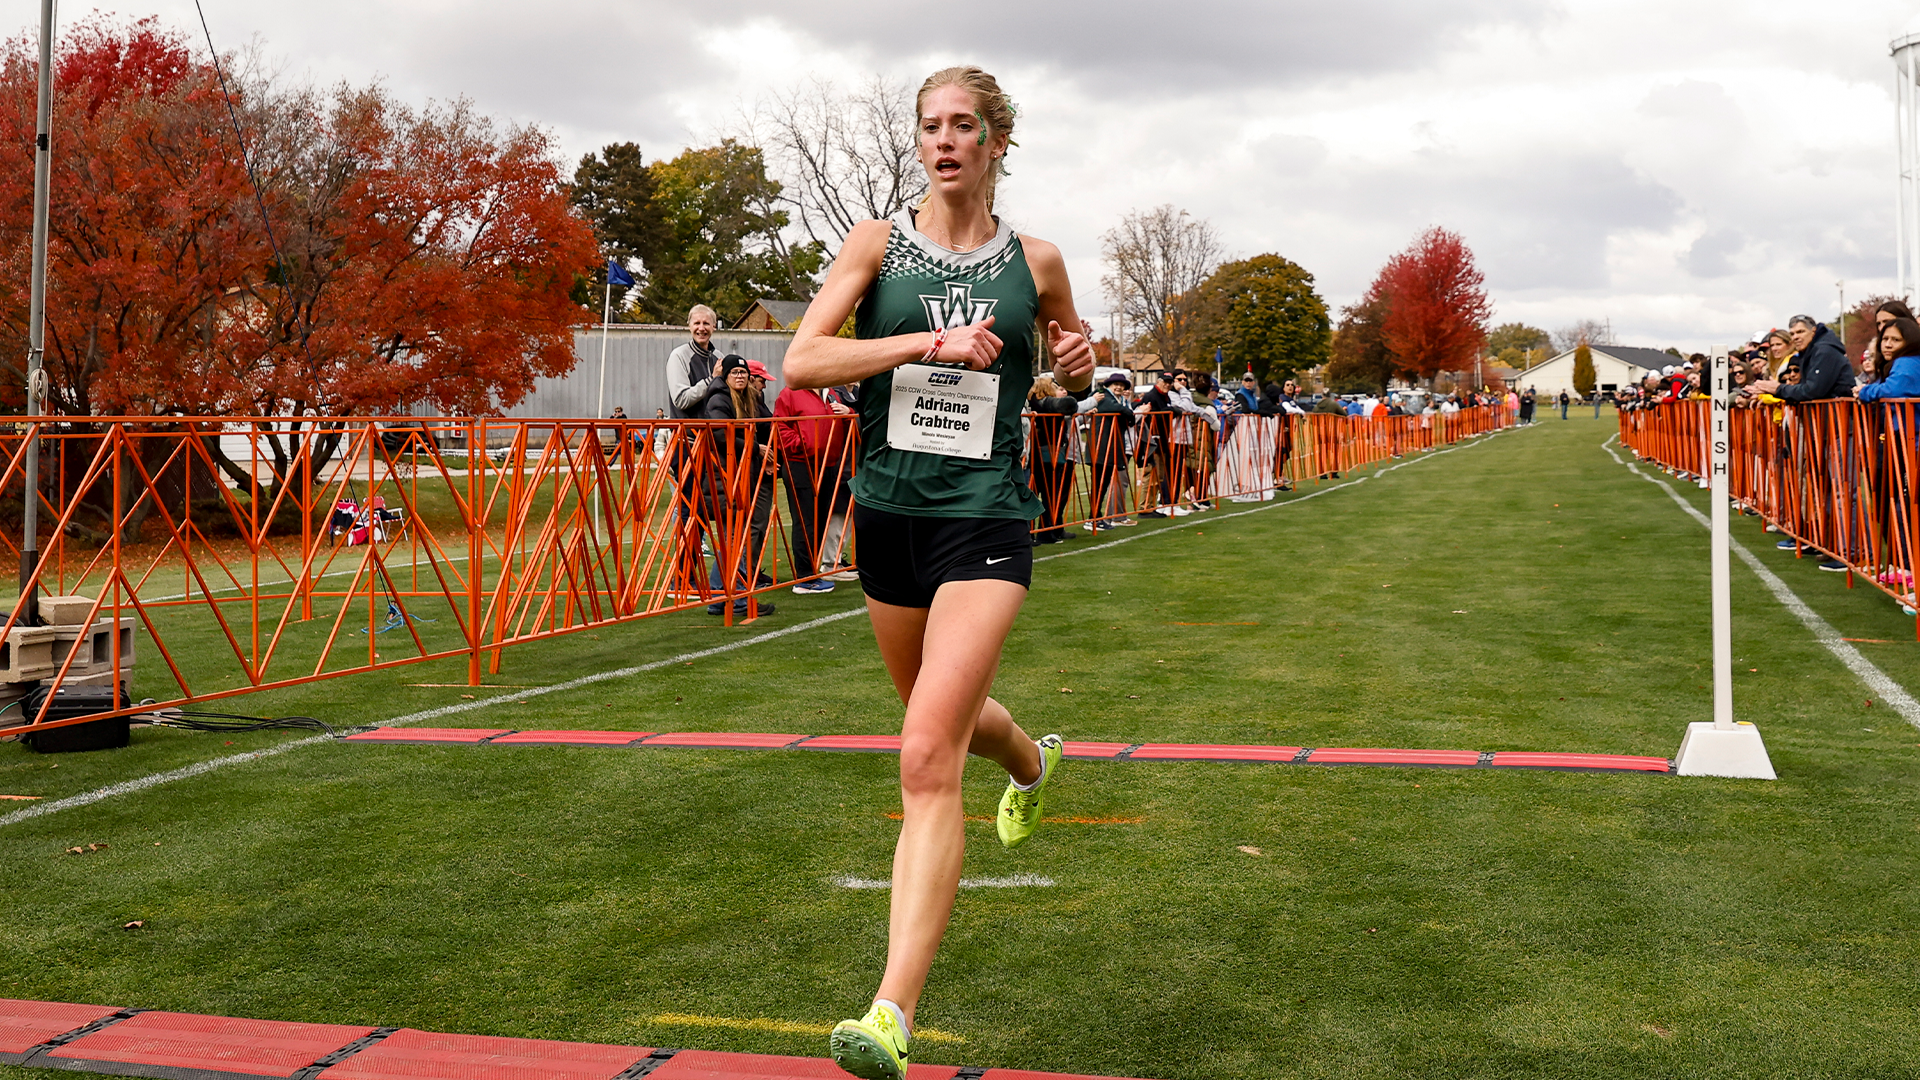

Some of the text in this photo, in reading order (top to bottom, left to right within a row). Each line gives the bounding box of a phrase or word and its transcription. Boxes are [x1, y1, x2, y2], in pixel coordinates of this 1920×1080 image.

[928, 372, 963, 385] CCIW
[922, 388, 936, 396] Cross
[937, 390, 956, 399] Country
[957, 392, 993, 402] Championships
[915, 396, 969, 414] Adriana
[911, 412, 970, 431] Crabtree
[1714, 356, 1726, 475] FINISH
[912, 442, 962, 454] Augustana College
